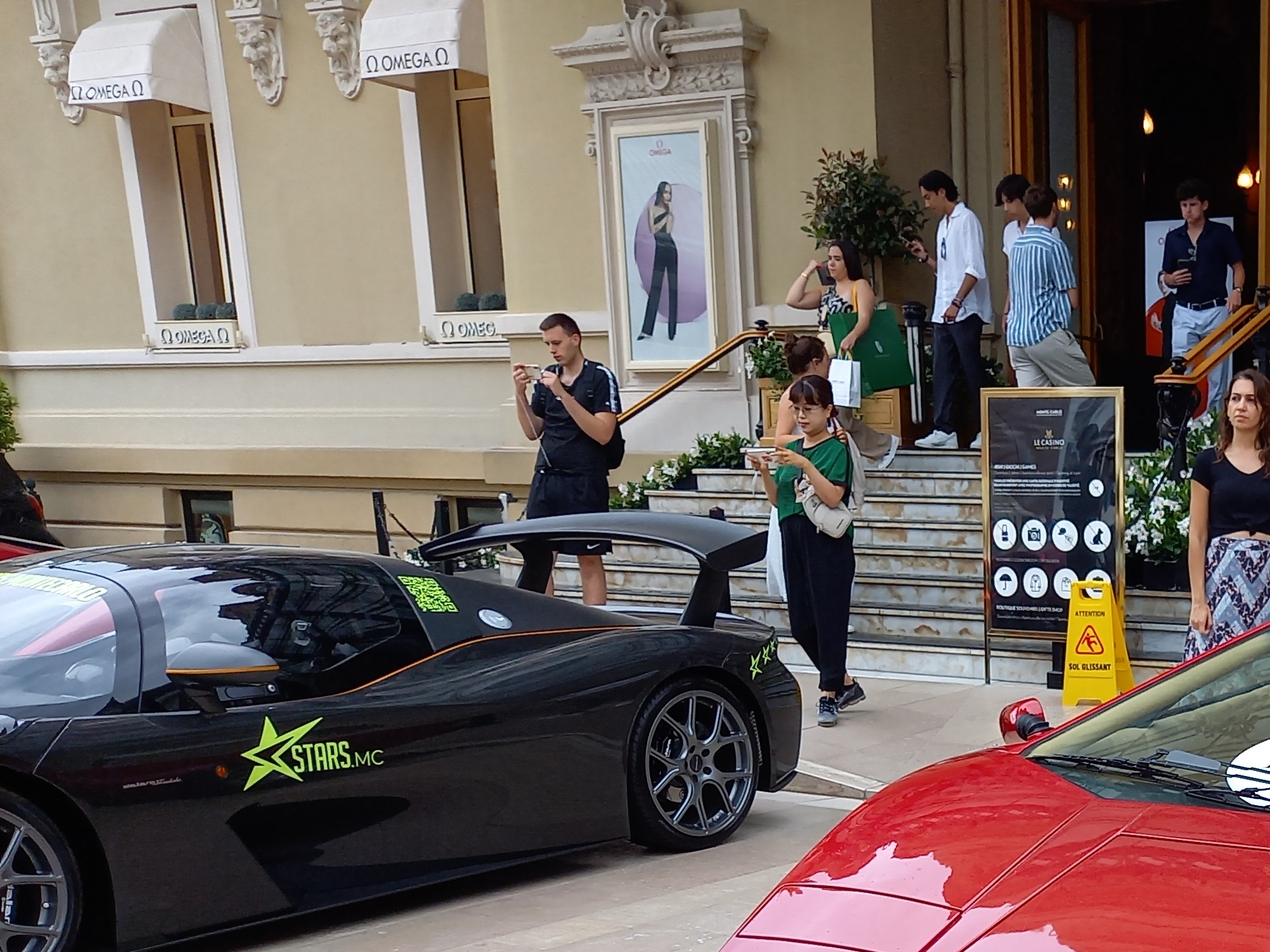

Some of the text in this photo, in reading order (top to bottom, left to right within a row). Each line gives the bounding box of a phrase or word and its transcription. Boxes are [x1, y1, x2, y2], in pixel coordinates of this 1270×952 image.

[381, 52, 433, 72] OMEGA
[85, 84, 131, 100] OMEGA
[175, 329, 216, 344] OMEGA
[458, 322, 496, 337] OMEG
[1069, 663, 1111, 671] SOL GLISSANT
